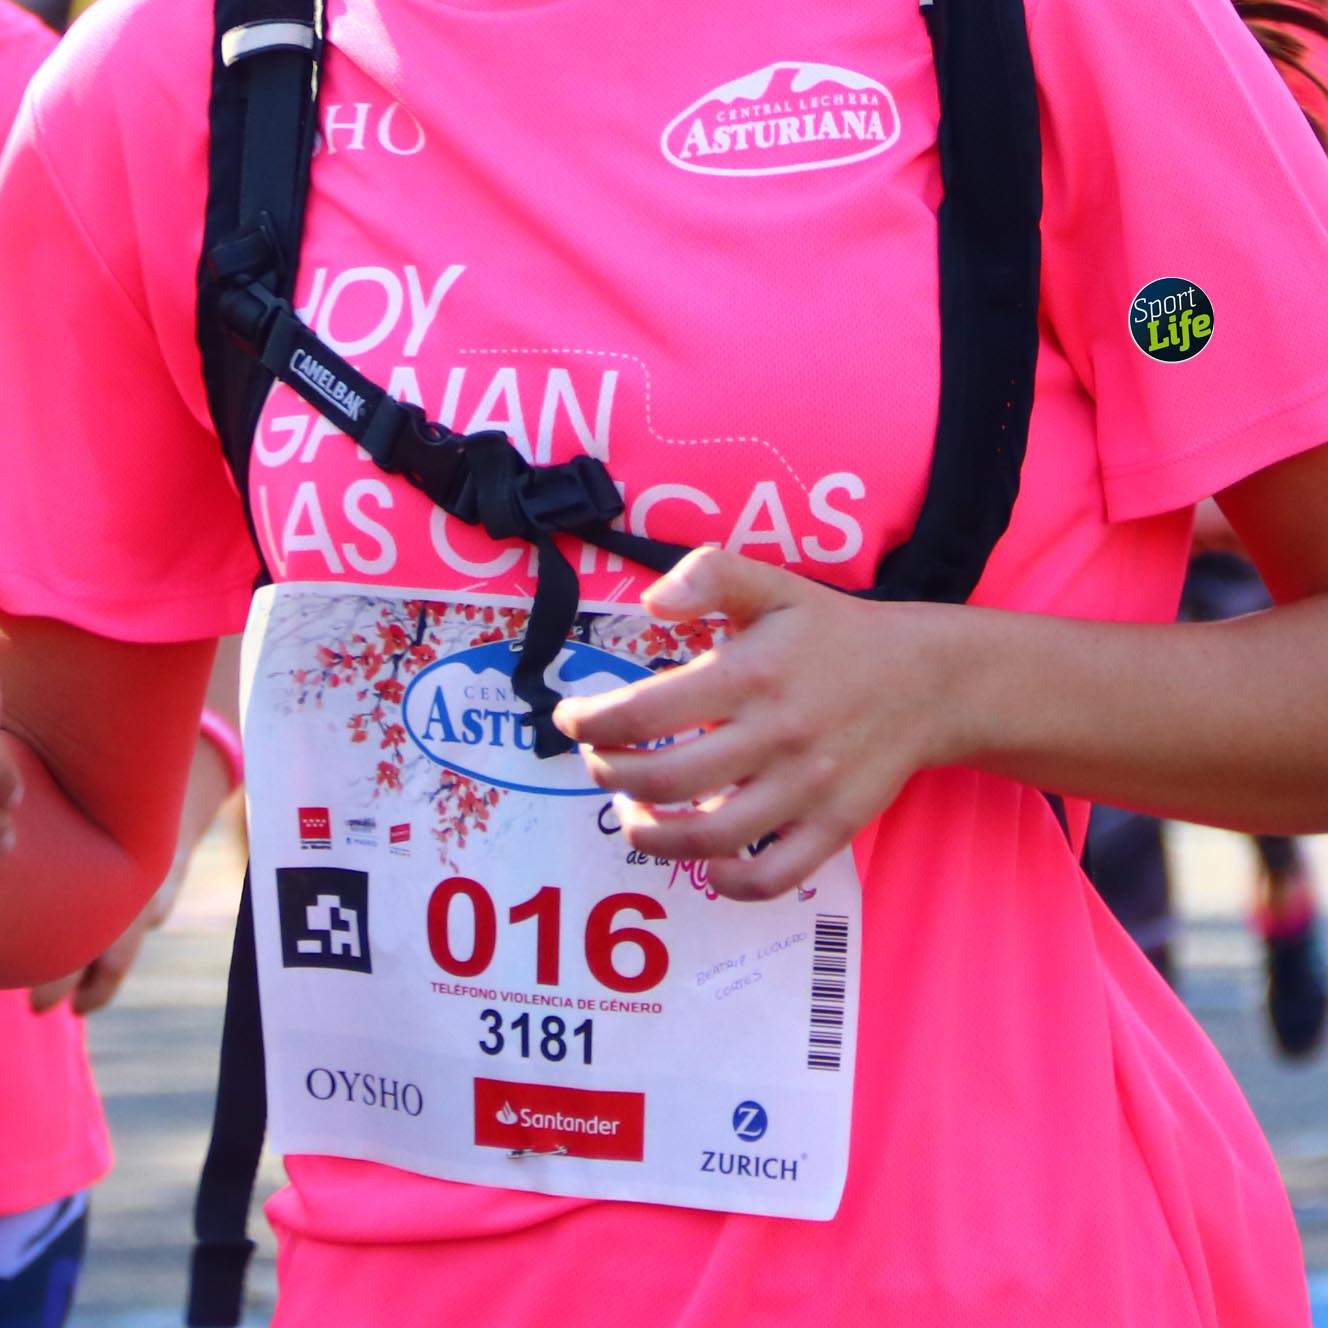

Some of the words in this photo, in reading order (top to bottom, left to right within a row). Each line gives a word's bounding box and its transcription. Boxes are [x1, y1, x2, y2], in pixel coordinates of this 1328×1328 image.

[715, 100, 792, 122] CENTRAL
[799, 92, 880, 110] LECHERA
[678, 110, 887, 160] ASTURIANA
[1134, 286, 1196, 323] Sport
[1147, 309, 1212, 352] Life
[289, 348, 367, 422] CAMELBAK
[426, 876, 670, 994] 016
[431, 981, 498, 1001] TELÉFONO
[500, 991, 574, 1009] VIOLENCIA
[577, 998, 596, 1010] DE
[600, 998, 663, 1014] GÉNERO
[479, 1008, 594, 1065] 3181
[306, 1067, 424, 1117] OYSHO
[520, 1108, 621, 1136] Santander
[701, 1151, 798, 1181] ZURICH
